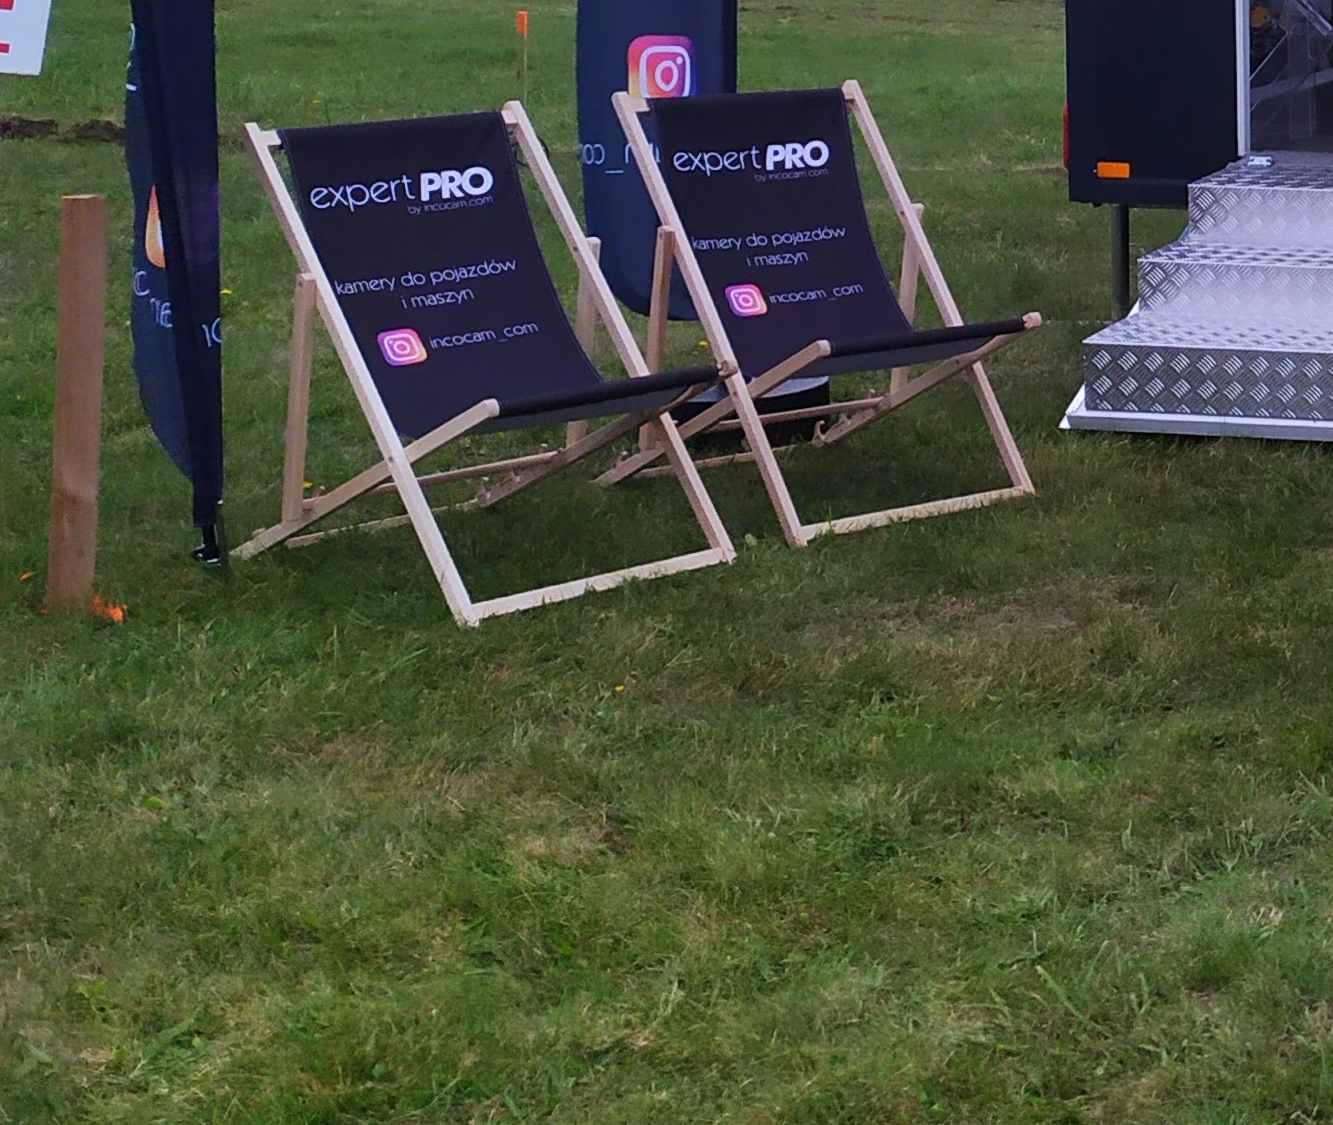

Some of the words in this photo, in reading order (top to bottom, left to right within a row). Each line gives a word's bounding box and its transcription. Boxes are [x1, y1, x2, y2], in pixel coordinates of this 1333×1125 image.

[673, 149, 761, 177] expert
[765, 140, 830, 171] PRO
[310, 175, 415, 213] expert
[420, 166, 494, 201] PRO
[407, 205, 421, 215] by
[424, 194, 494, 213] incocam.com
[692, 236, 742, 252] kamery
[746, 233, 768, 247] do
[772, 227, 847, 247] pojazdów
[754, 250, 809, 266] maszyn
[334, 275, 395, 295] kamery
[400, 270, 426, 288] do
[430, 259, 517, 286] pojazdów
[411, 287, 474, 307] maszyn
[768, 282, 864, 303] incocam_com
[429, 321, 539, 349] incocam_com
